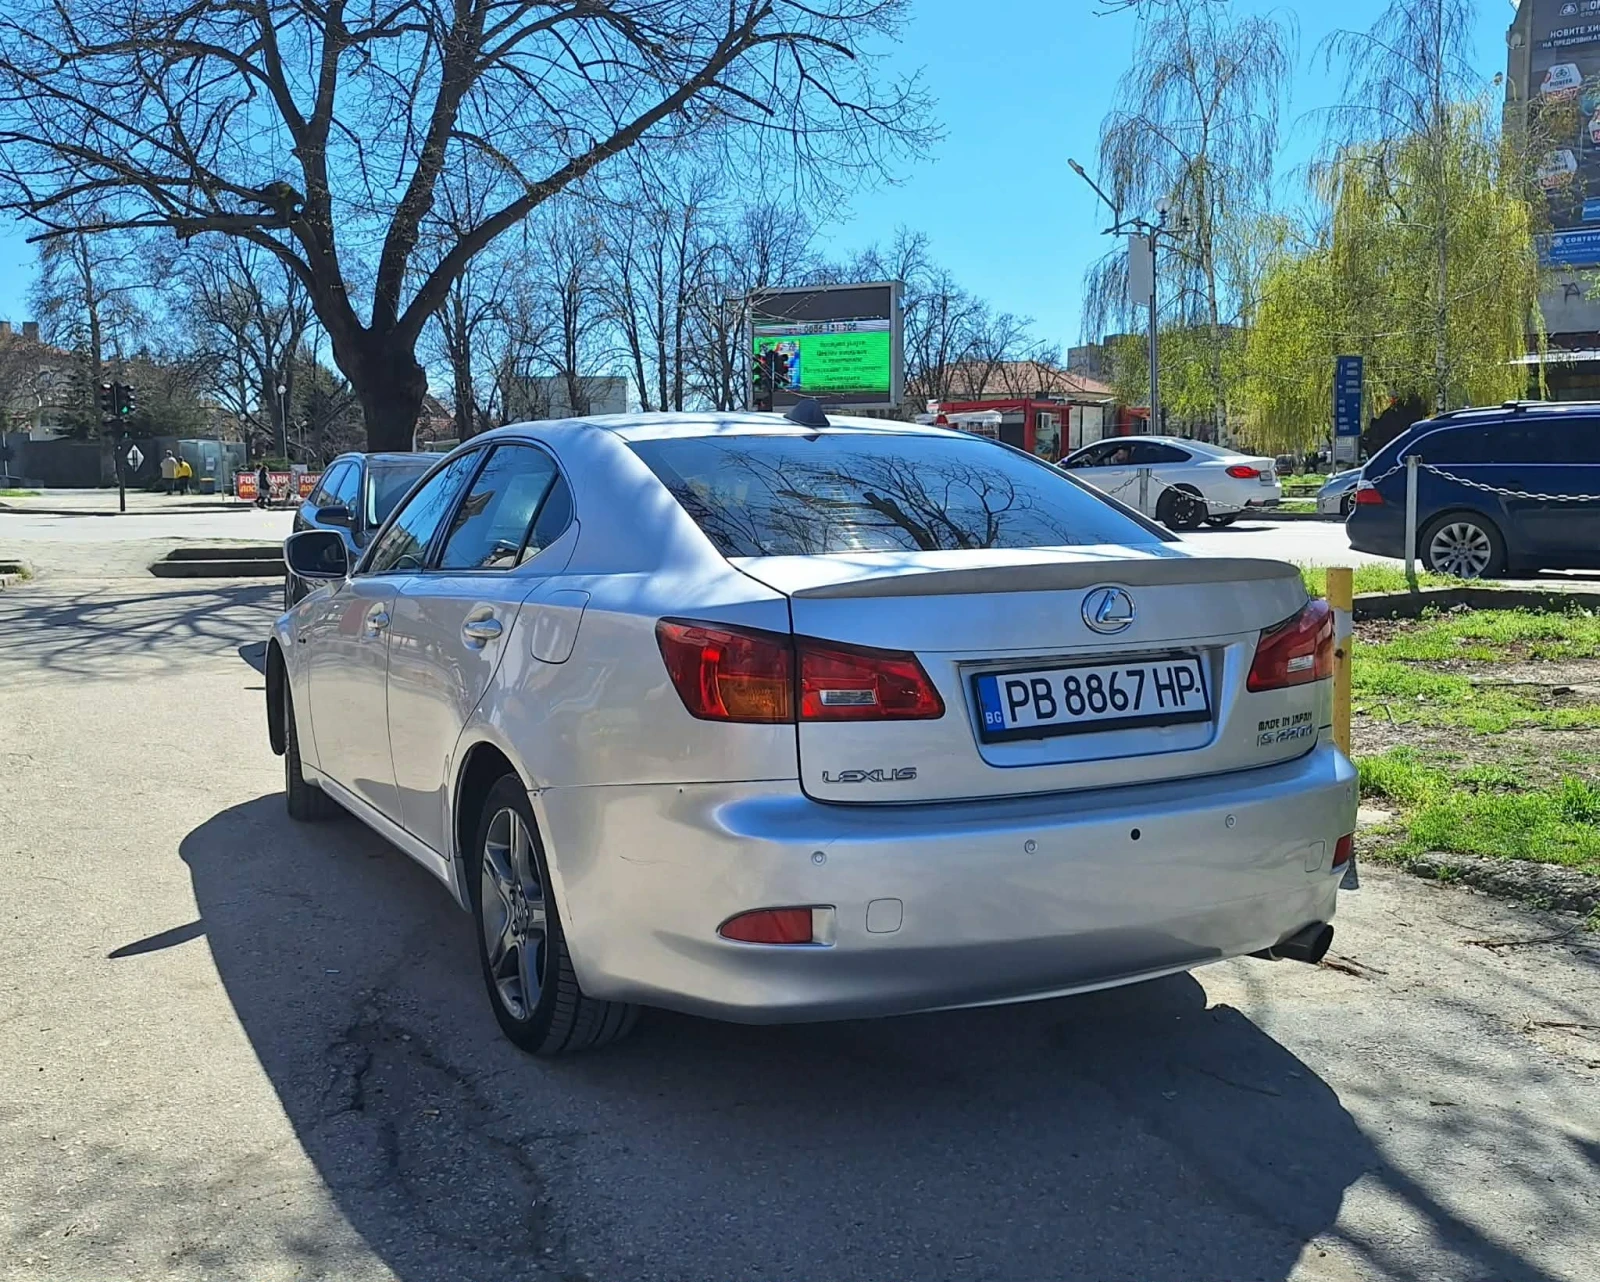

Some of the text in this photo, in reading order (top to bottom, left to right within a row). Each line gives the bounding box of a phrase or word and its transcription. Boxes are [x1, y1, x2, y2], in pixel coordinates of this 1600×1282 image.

[1550, 24, 1600, 38] НОВИТЕ ХИ
[986, 710, 1002, 724] BG
[1005, 677, 1057, 723] PB
[1063, 669, 1146, 716] 8867
[1258, 710, 1312, 731] MADE IN JAPAN
[1256, 732, 1275, 748] IS
[822, 766, 918, 783] LEXUS
